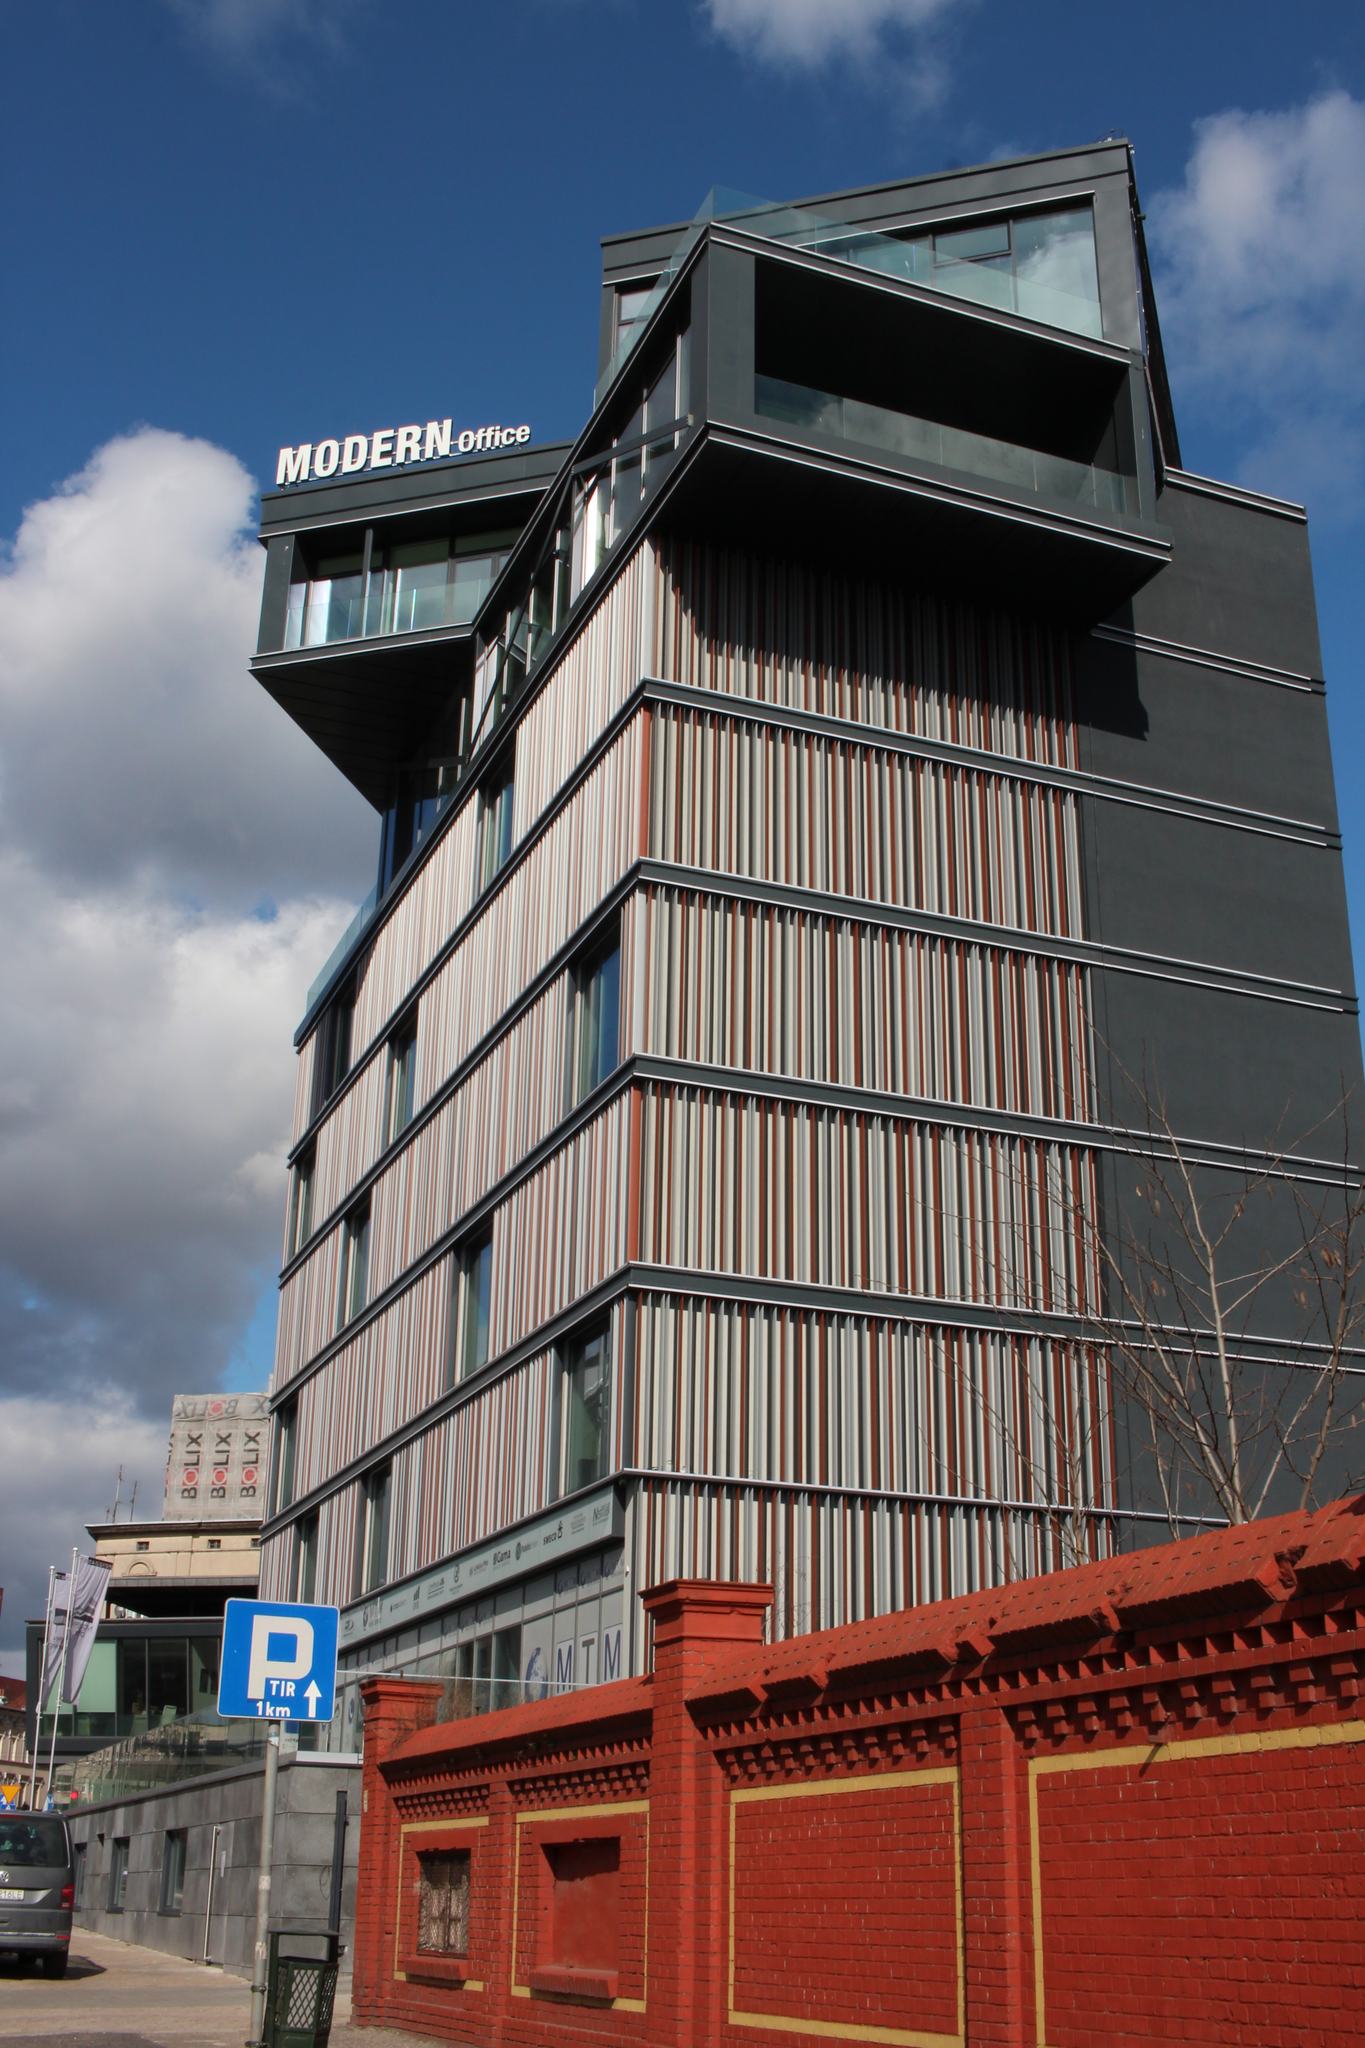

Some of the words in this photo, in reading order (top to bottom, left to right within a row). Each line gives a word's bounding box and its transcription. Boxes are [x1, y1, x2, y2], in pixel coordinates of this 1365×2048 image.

[276, 419, 452, 485] MODERN
[181, 1433, 203, 1499] BOLIX
[210, 1432, 232, 1498] BOLIX
[240, 1431, 260, 1498] BOLIX
[247, 1614, 314, 1700] P
[270, 1680, 296, 1697] TIR
